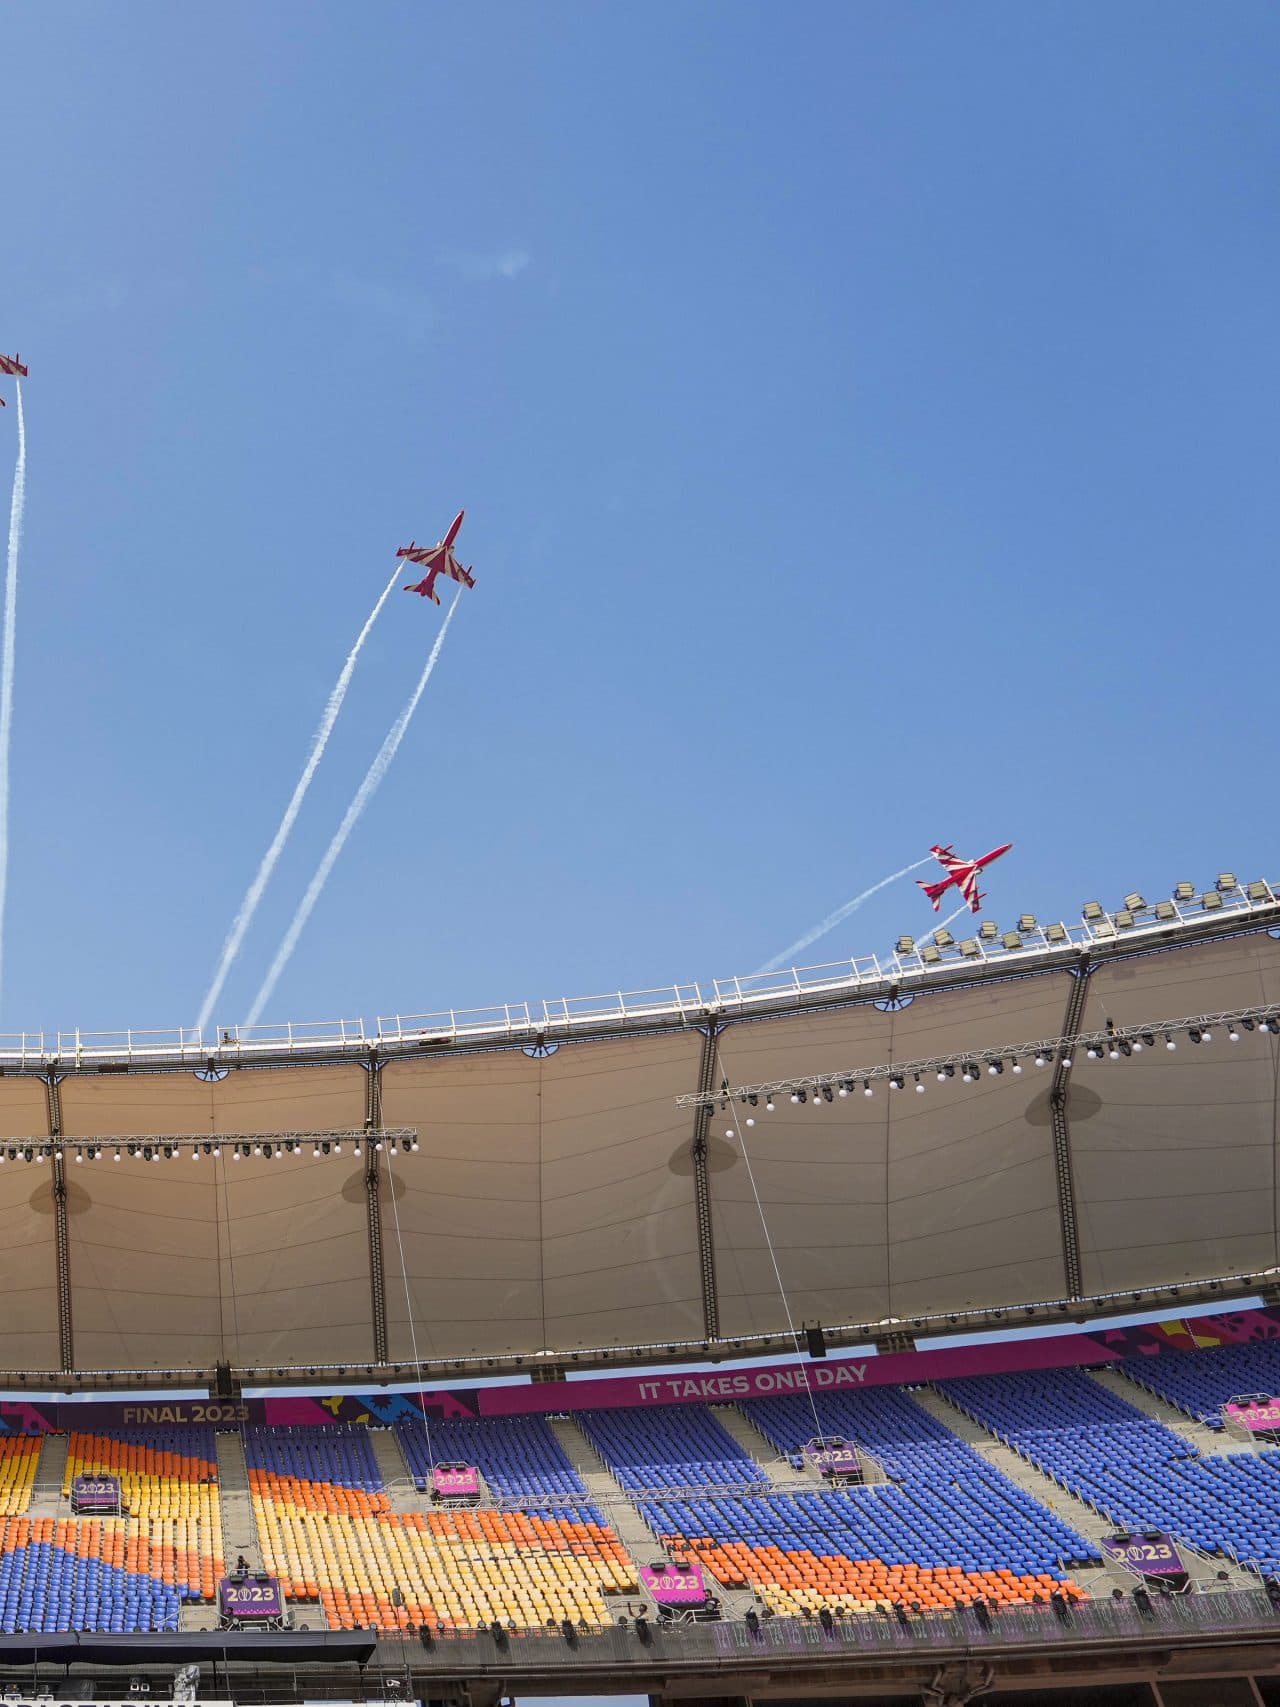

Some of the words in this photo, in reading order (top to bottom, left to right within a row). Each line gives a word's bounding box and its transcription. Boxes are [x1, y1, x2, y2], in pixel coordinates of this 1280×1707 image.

[639, 1382, 661, 1399] IT
[666, 1375, 750, 1397] TAKES
[755, 1369, 812, 1391] ONE
[814, 1364, 868, 1386] DAY
[123, 1406, 188, 1424] FINAL
[191, 1405, 250, 1422] 2023
[79, 1481, 114, 1494] 2023
[647, 1573, 700, 1591] 2023
[226, 1586, 275, 1602] 2023
